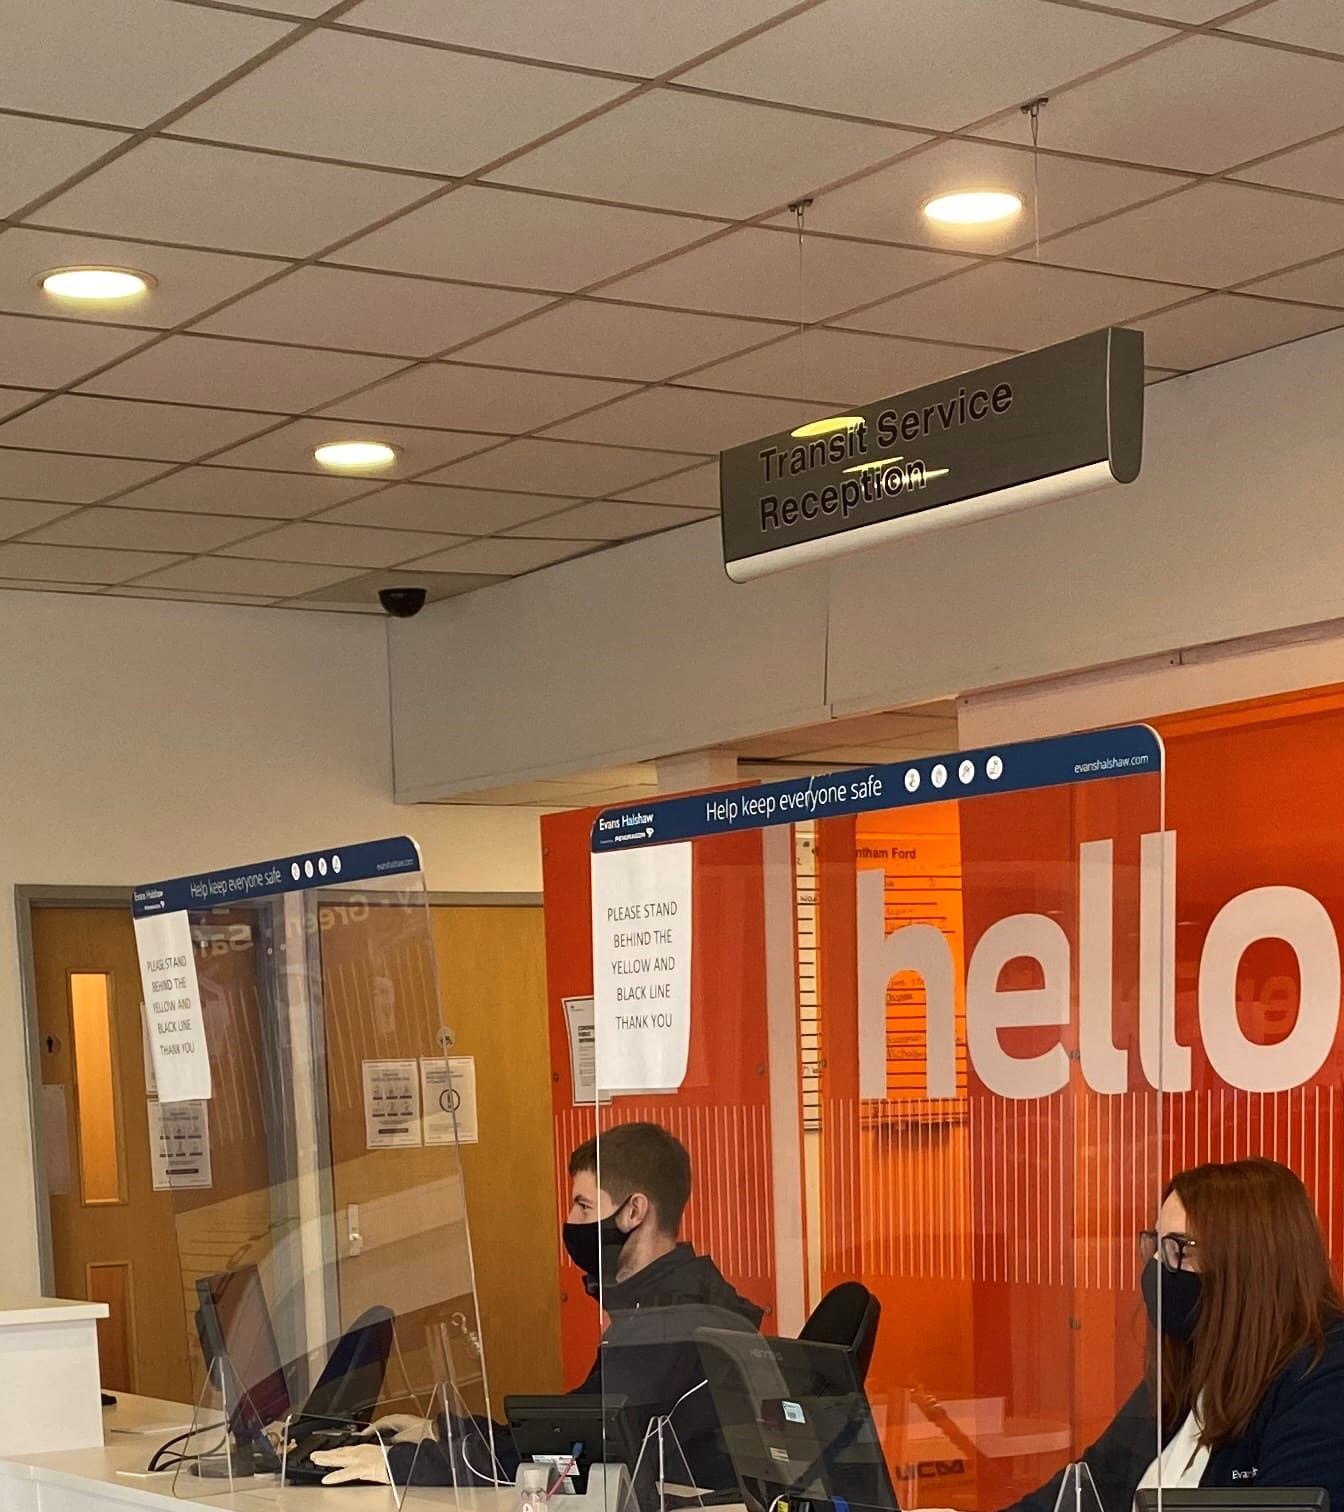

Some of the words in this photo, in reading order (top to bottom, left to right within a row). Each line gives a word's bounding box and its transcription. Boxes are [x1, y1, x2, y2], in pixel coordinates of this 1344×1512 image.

[759, 419, 868, 483] Transit
[877, 382, 1013, 449] Service
[760, 459, 926, 532] Reception
[1074, 753, 1149, 773] evanshalshaw.com
[706, 800, 738, 824] Help
[742, 795, 775, 819] keep
[779, 785, 847, 812] everyone
[851, 774, 882, 801] safe
[599, 817, 619, 832] Evans
[621, 812, 654, 828] Halshaw
[190, 881, 207, 898] Help
[209, 878, 227, 896] keep
[228, 871, 263, 893] everyone
[265, 868, 282, 887] safe
[607, 903, 641, 922] PLEASE
[644, 900, 677, 919] STAND
[613, 930, 650, 949] BEHIND
[654, 929, 672, 946] THE
[611, 957, 649, 976] YELLOW
[654, 956, 675, 972] AND
[856, 830, 1341, 1100] hello
[617, 984, 647, 1001] BLACK
[651, 983, 670, 999] LINE
[616, 1014, 648, 1031] THANK
[651, 1013, 672, 1029] YOU
